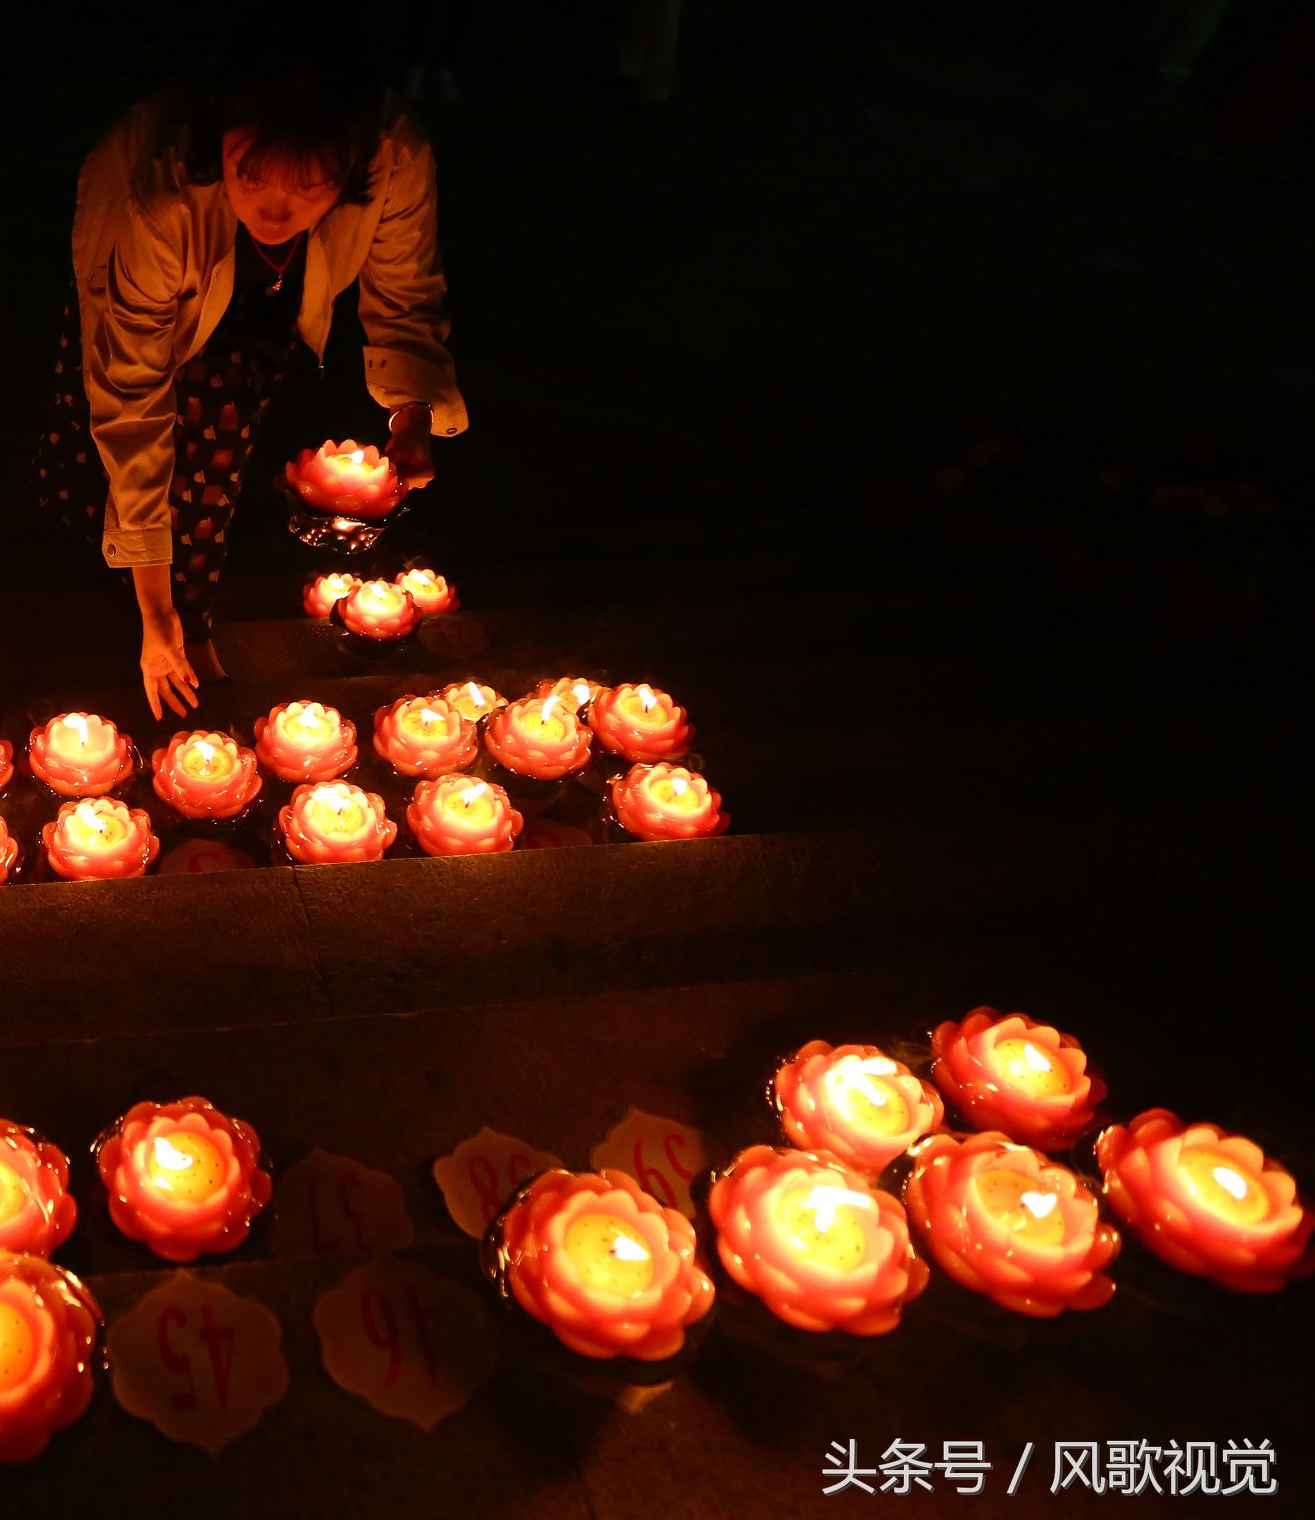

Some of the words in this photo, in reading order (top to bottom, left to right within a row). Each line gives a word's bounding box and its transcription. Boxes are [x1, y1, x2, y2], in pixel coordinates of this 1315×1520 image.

[308, 1173, 375, 1254] 37
[157, 1305, 235, 1411] 45
[360, 1285, 440, 1388] 46
